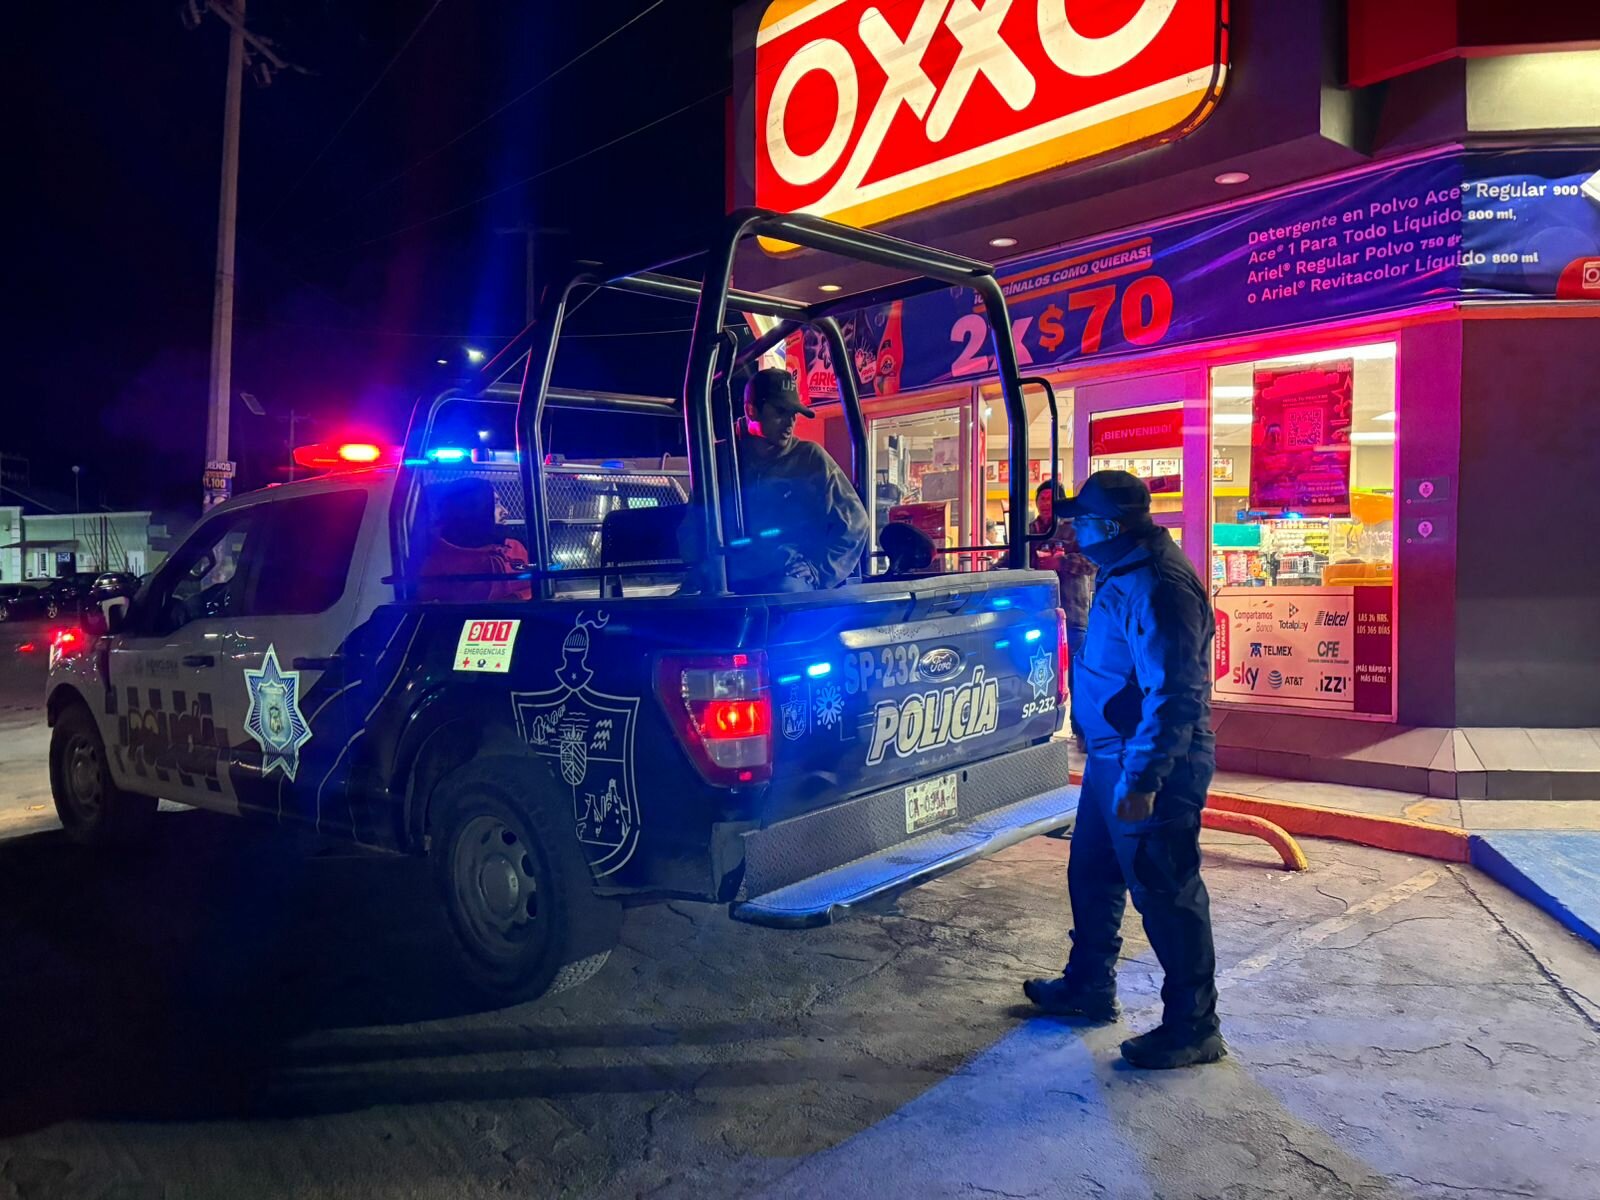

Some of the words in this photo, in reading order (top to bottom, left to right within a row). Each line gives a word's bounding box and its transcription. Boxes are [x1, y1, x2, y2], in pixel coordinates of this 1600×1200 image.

[766, 0, 1180, 197] OXXO
[1248, 215, 1337, 245] Detergente
[1342, 209, 1363, 223] en
[1370, 197, 1418, 217] Polvo
[1476, 181, 1547, 201] Regular
[1552, 185, 1579, 196] 900
[1288, 242, 1295, 256] 1
[1300, 236, 1338, 253] Para
[1343, 223, 1387, 244] Todo
[1393, 207, 1462, 233] Líquido
[1467, 210, 1494, 220] 800
[1052, 262, 1088, 283] COMO
[1091, 245, 1152, 274] QUIERAS!
[1296, 251, 1360, 274] Regular
[1365, 241, 1414, 261] Polvo
[1420, 236, 1444, 249] 750
[1247, 293, 1257, 304] o
[1310, 263, 1410, 292] Revitacolor
[1415, 250, 1486, 272] Líquido
[1492, 253, 1518, 264] 800
[1521, 252, 1539, 263] ml
[1038, 275, 1174, 354] $70
[809, 372, 837, 386] ARIE
[1101, 424, 1173, 442] ¡BIENVENIDO!
[1234, 609, 1273, 622] Compartamos
[1255, 622, 1273, 632] Banco
[1323, 611, 1350, 627] telcel
[470, 623, 508, 640] 911
[464, 648, 507, 656] EMERGENCIAS
[1263, 645, 1293, 657] TELMEX
[1317, 640, 1340, 658] CFE
[844, 643, 921, 695] SP-232
[1232, 661, 1260, 690] sky
[1284, 676, 1304, 686] AT&T
[866, 665, 999, 766] POLICÍA
[1021, 696, 1056, 719] SP-232
